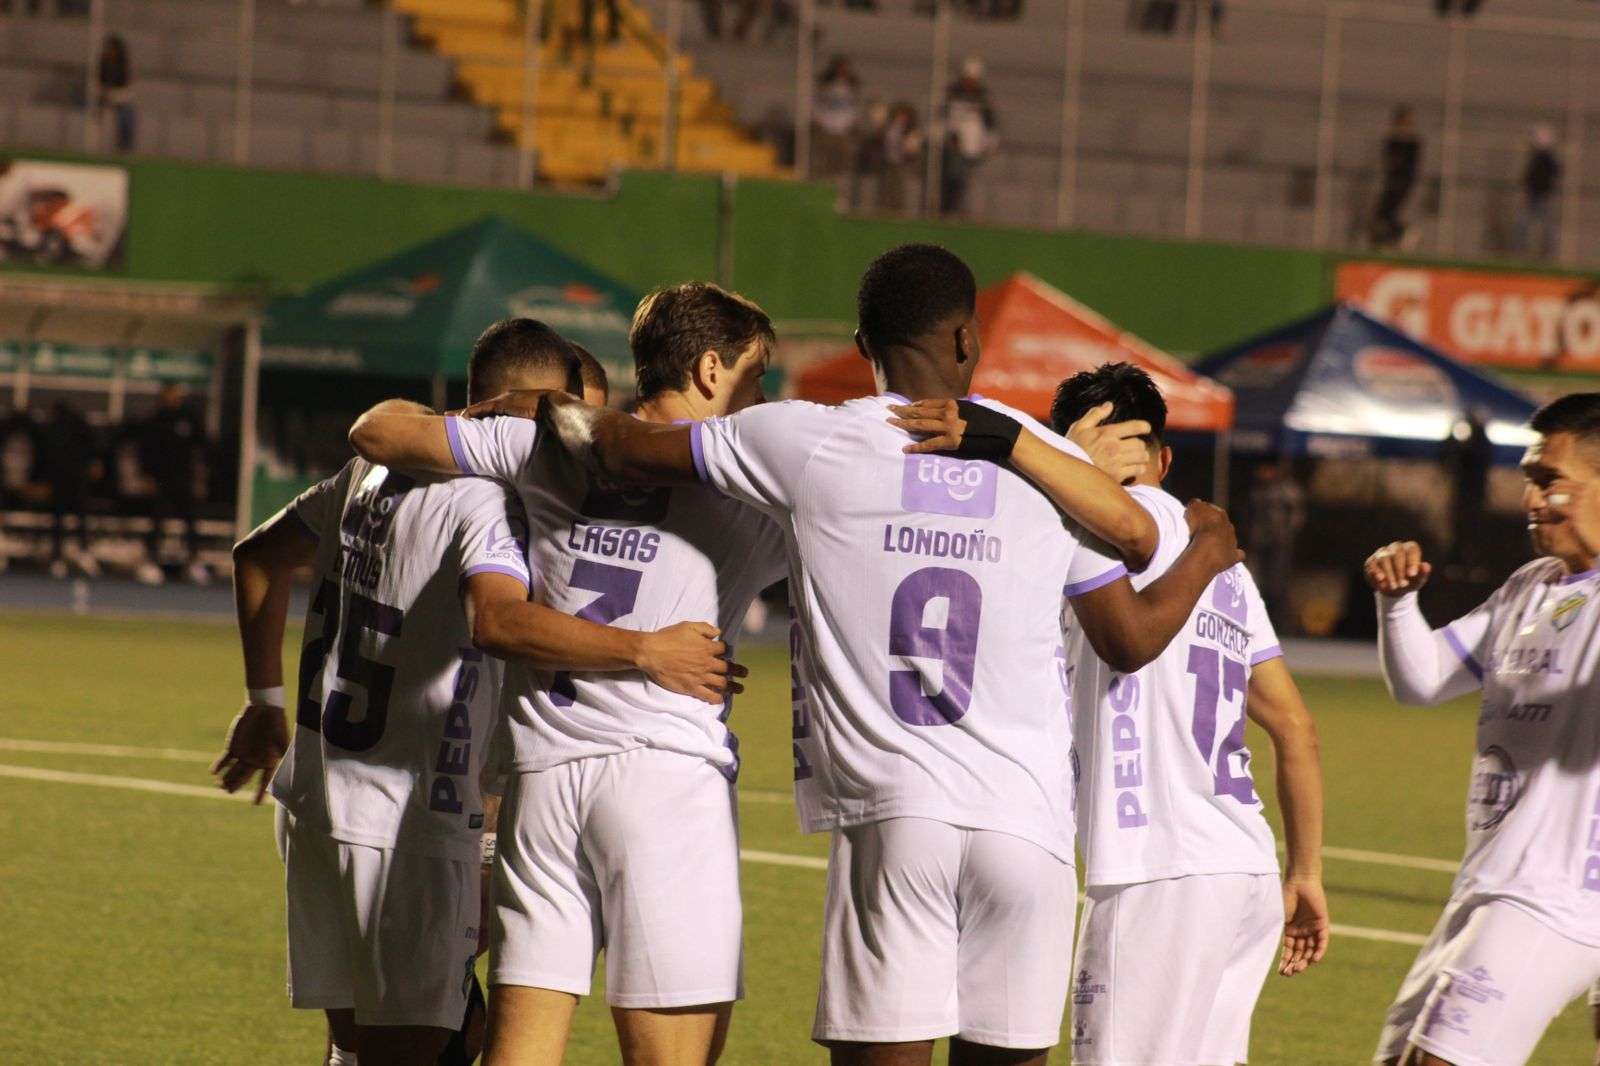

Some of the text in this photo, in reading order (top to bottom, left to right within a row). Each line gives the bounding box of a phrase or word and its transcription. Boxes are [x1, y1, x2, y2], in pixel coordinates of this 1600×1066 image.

[568, 519, 661, 564] CASAS
[883, 523, 1003, 564] LONDOÑO
[917, 458, 984, 488] tigo
[297, 578, 405, 752] 25
[549, 558, 644, 707] 7
[889, 566, 983, 727] 9
[1187, 644, 1256, 805] 12
